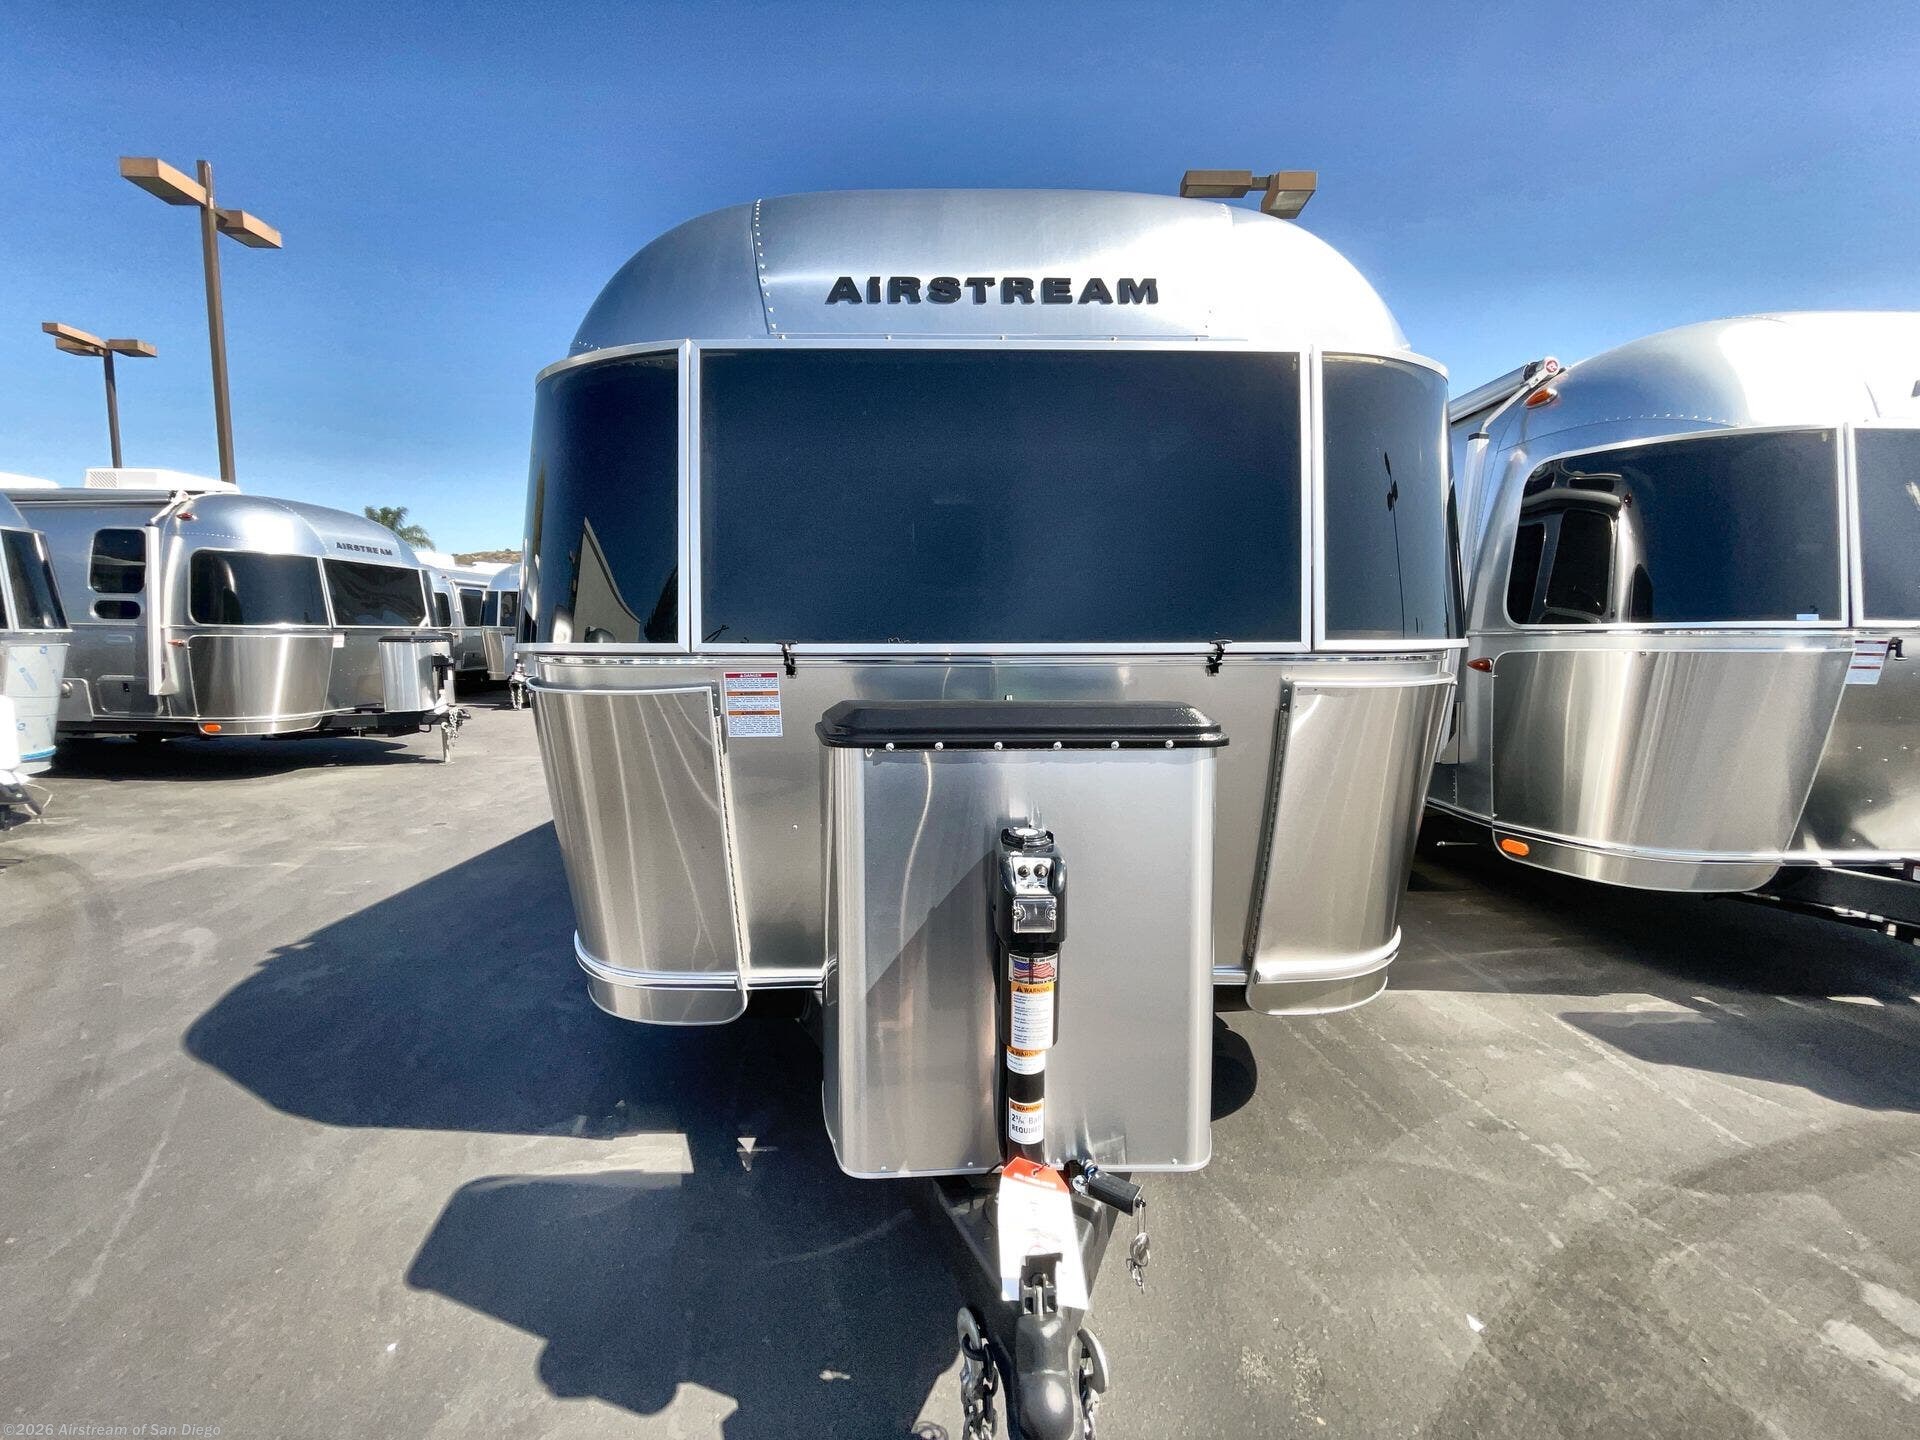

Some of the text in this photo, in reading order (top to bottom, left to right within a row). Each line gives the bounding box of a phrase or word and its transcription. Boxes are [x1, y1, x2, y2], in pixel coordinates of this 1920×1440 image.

[825, 276, 1159, 305] AIRSTREAM
[336, 542, 393, 556] AIRSTREAM
[1024, 985, 1050, 994] WARNING
